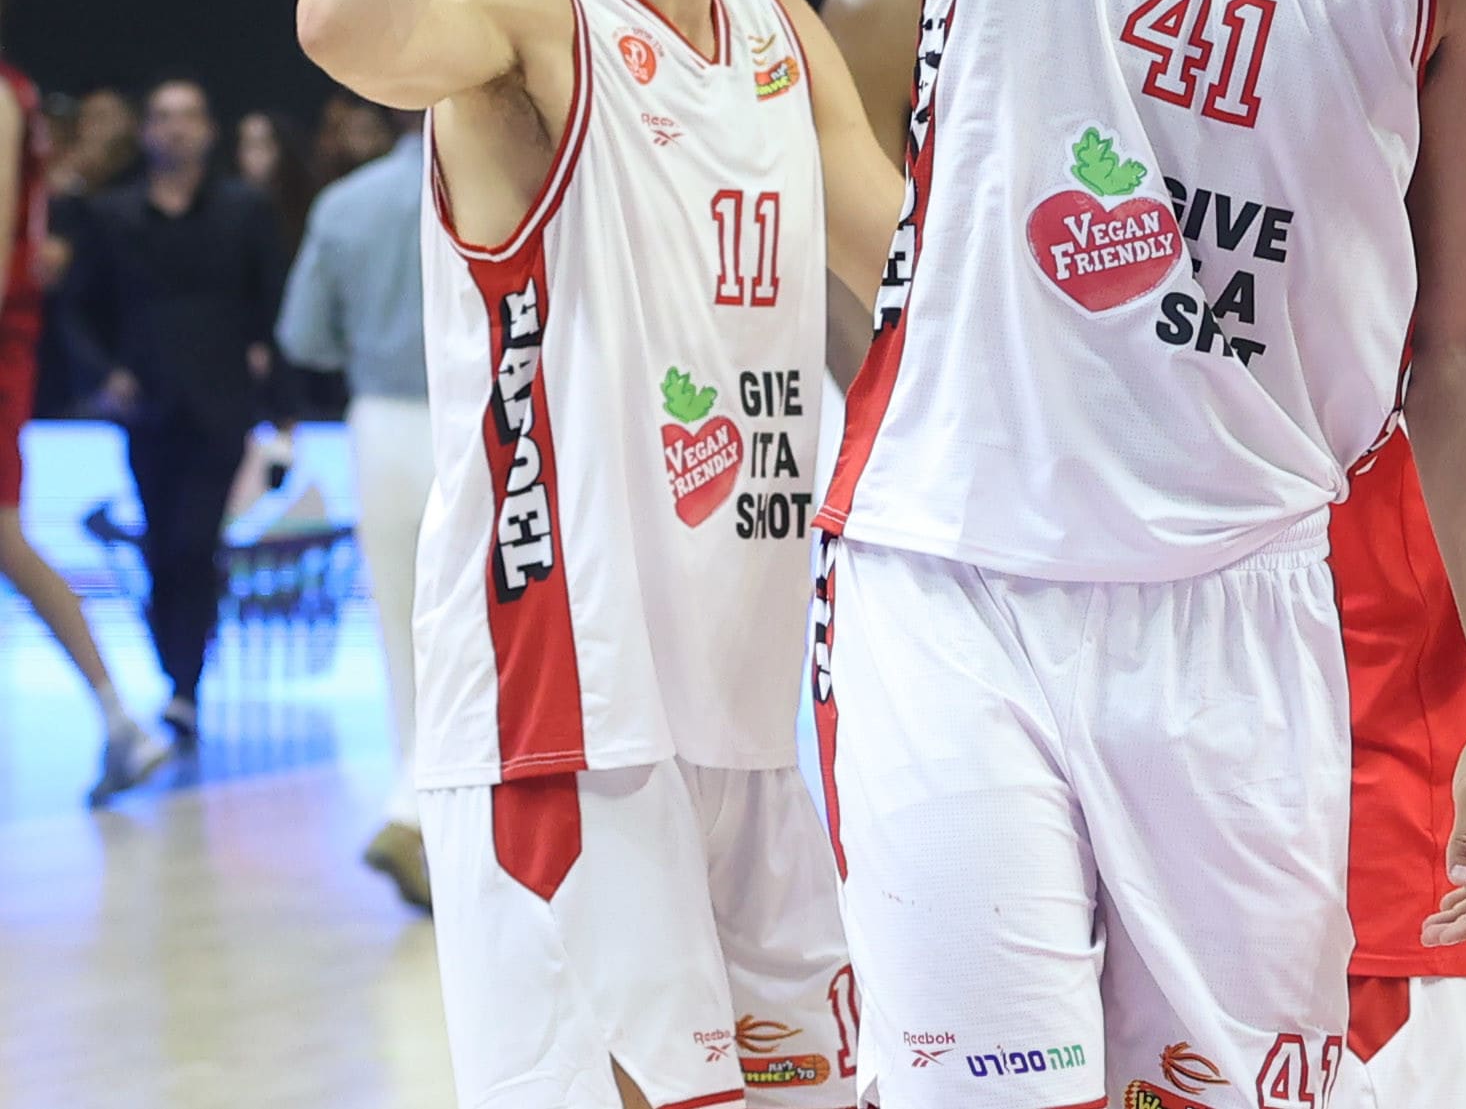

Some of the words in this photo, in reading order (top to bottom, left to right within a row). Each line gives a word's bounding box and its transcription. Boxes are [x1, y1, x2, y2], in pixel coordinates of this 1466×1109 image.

[711, 189, 781, 307] 11
[740, 370, 803, 417] GIVE
[751, 432, 774, 478] IT
[774, 432, 800, 478] A
[736, 492, 812, 540] SHOT
[693, 1029, 735, 1045] Reebo
[903, 1031, 956, 1047] Reebok
[1046, 1043, 1086, 1071] מגה
